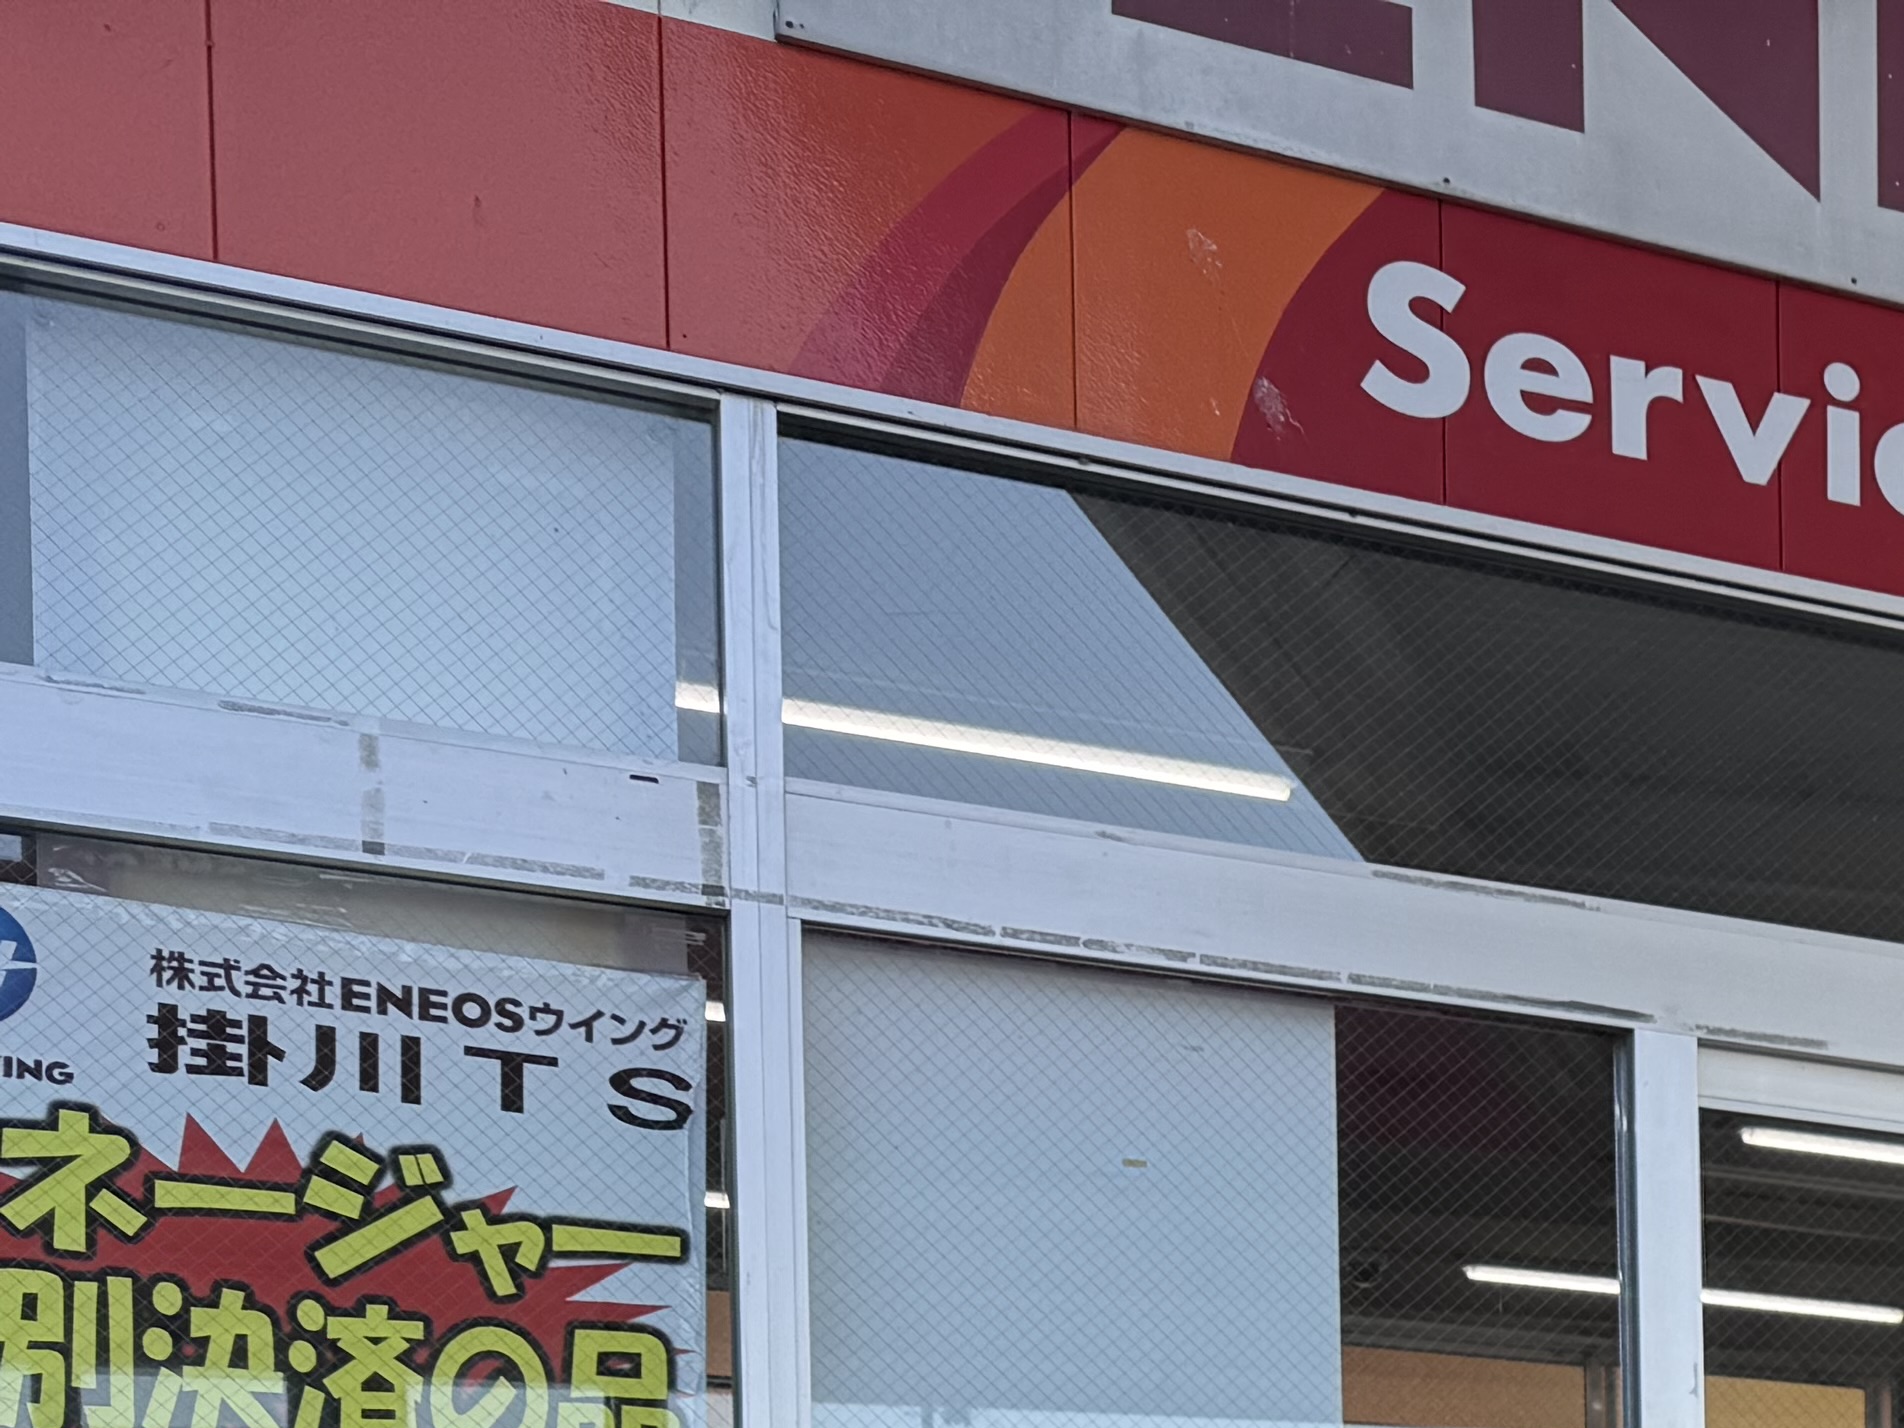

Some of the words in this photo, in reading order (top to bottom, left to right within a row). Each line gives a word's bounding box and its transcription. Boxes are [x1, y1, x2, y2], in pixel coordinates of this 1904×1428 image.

[150, 947, 689, 1052] 株式会社ENEOSウイング
[0, 1055, 75, 1086] ING
